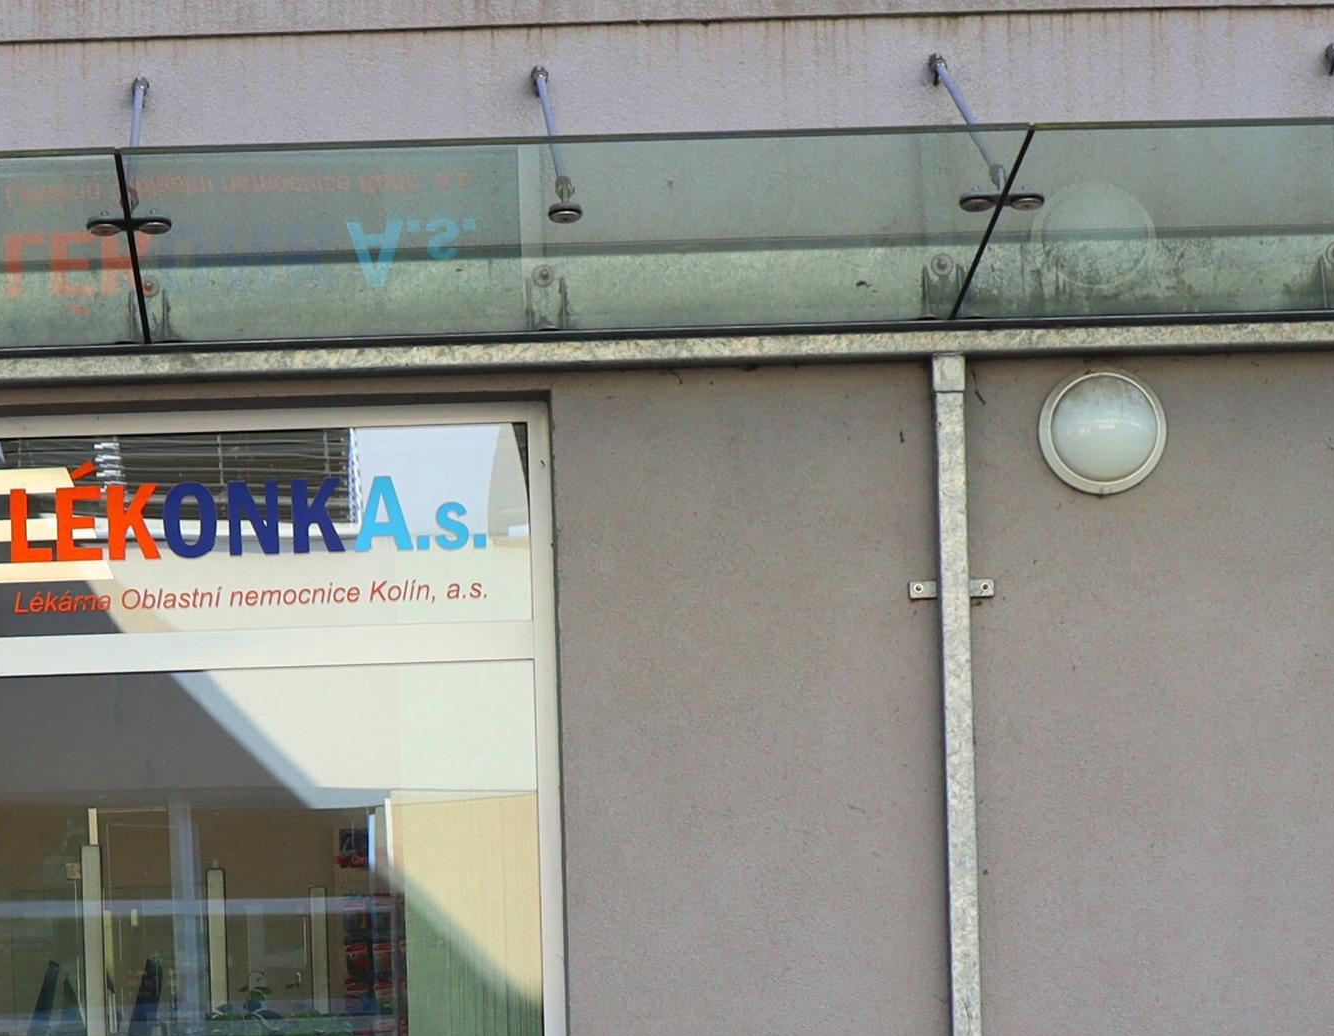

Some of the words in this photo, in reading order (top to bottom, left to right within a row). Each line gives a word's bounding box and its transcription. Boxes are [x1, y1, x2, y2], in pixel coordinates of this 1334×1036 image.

[14, 589, 111, 614] Lékárna
[120, 584, 222, 610] Oblastní
[229, 582, 360, 607] nemocnice
[369, 579, 436, 604] Kolín,
[446, 579, 488, 599] a.s.
